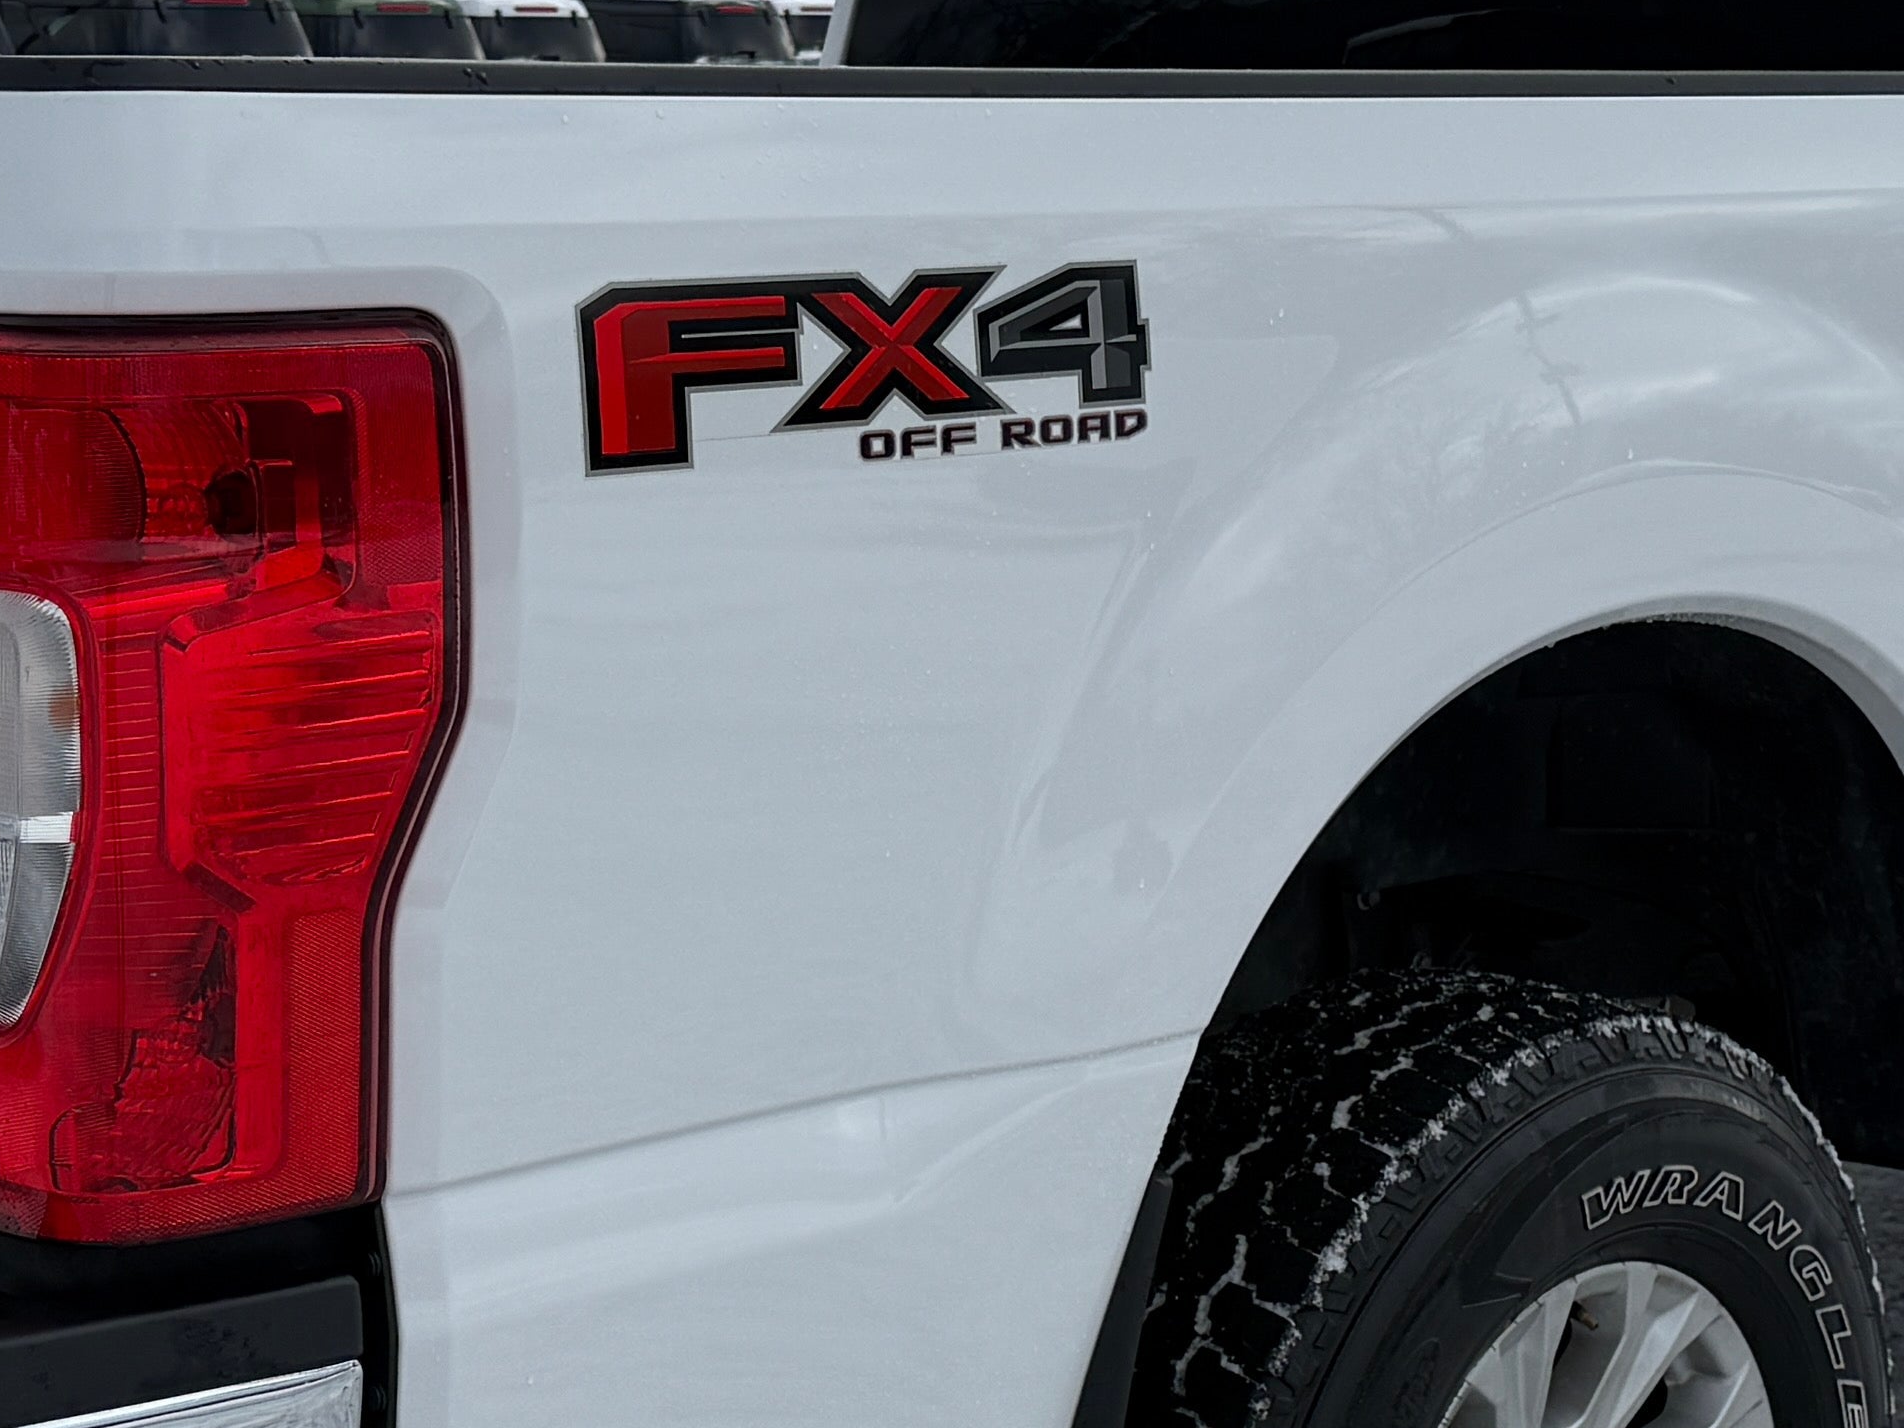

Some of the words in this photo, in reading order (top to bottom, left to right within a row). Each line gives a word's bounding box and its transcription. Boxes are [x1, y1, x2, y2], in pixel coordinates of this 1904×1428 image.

[574, 258, 1152, 477] FX4
[858, 423, 979, 463] OFF
[1000, 408, 1149, 450] ROAD
